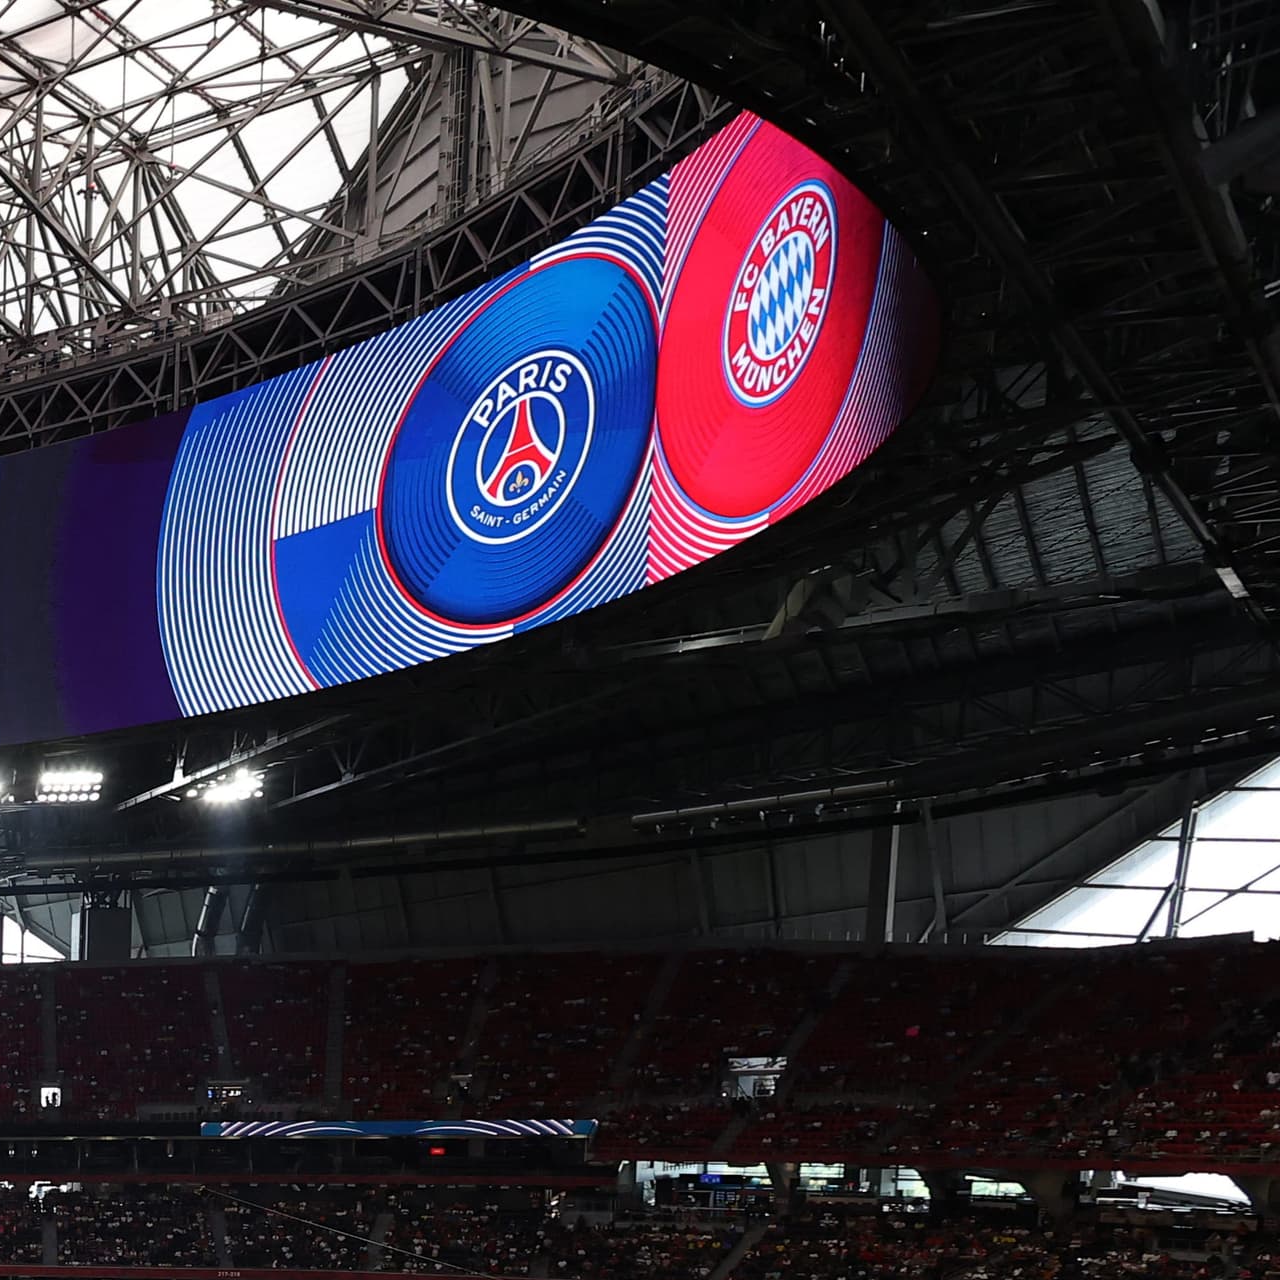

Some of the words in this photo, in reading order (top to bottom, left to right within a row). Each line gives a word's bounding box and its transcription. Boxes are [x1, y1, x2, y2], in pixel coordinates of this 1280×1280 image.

[734, 263, 758, 312] FC
[760, 197, 829, 257] BAYERN
[732, 288, 825, 392] MÜNCHEN
[472, 360, 572, 428] PARIS
[470, 505, 503, 528] SAINT
[513, 470, 567, 524] GERMAIN
